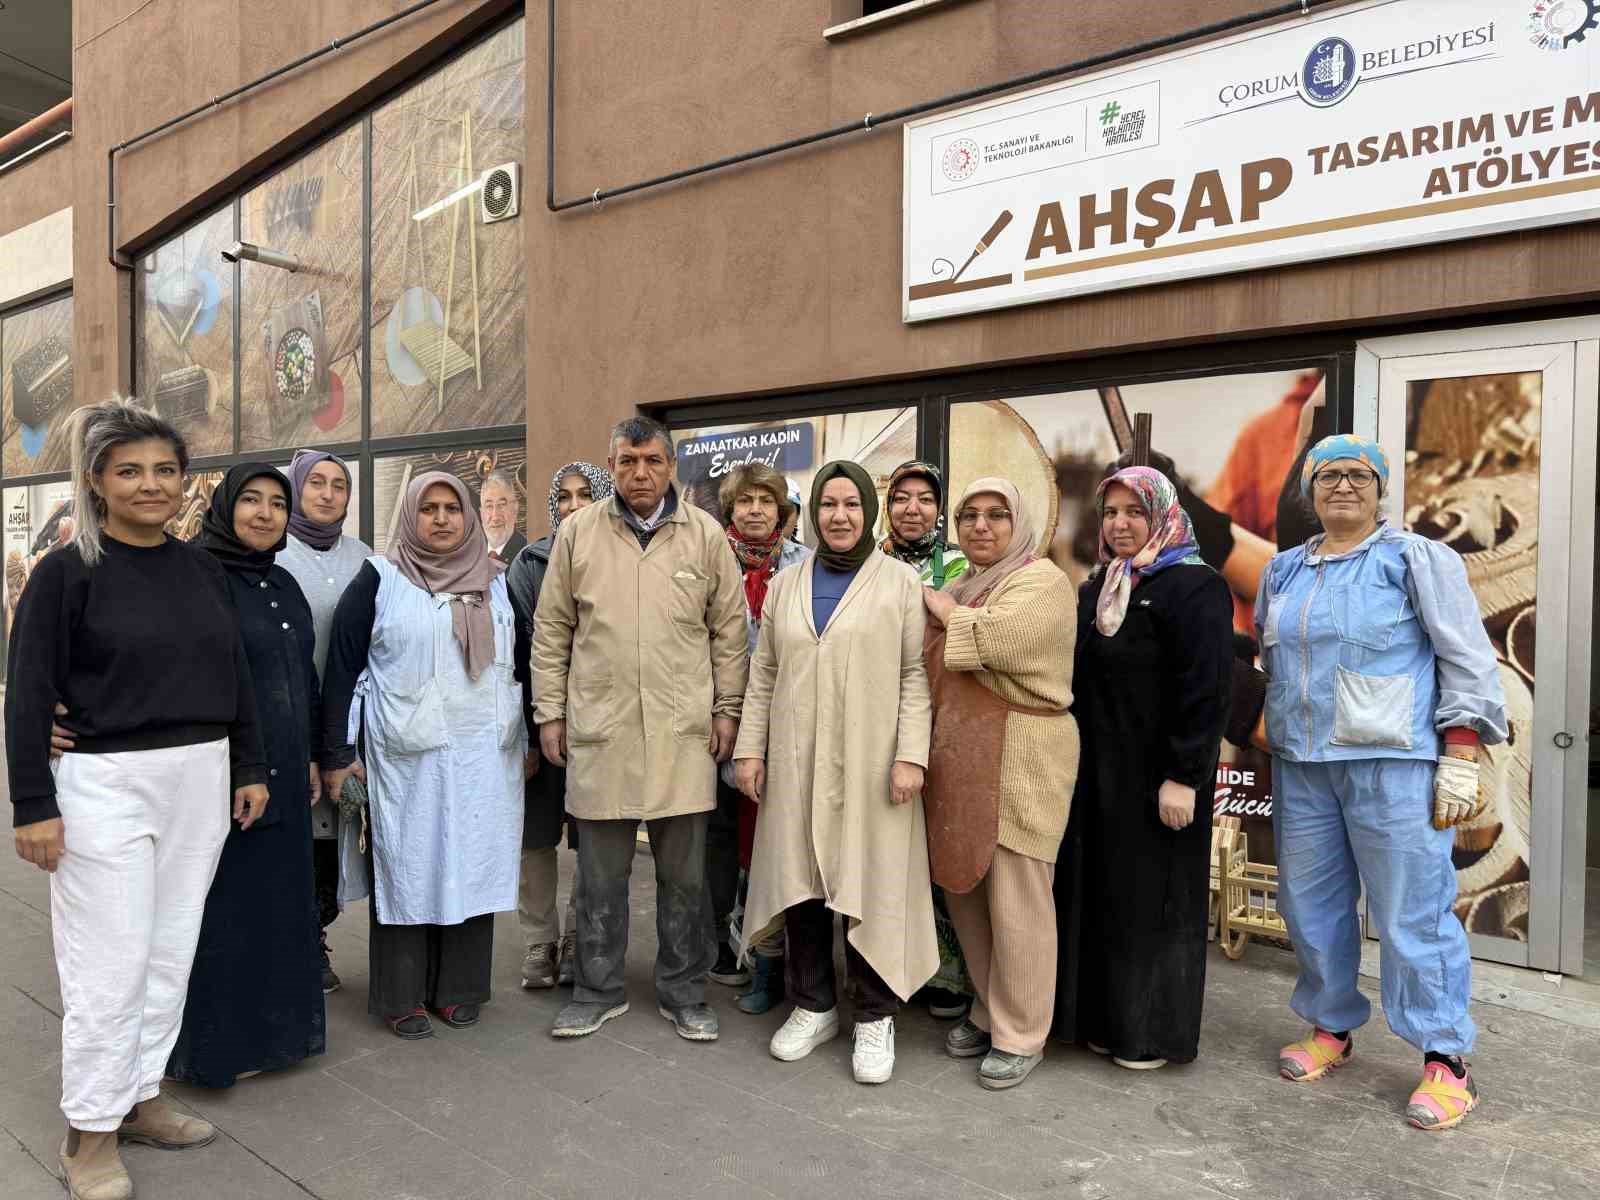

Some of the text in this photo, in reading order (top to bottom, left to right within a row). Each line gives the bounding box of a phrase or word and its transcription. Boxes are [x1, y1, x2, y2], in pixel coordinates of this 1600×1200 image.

[1218, 71, 1299, 107] ÇORUM
[1362, 21, 1495, 71] BELEDİYESİ
[984, 145, 1027, 163] TEKNOLOJİ
[1030, 134, 1041, 142] VE
[1307, 112, 1496, 176] TASARIM
[1504, 105, 1555, 138] VE
[1025, 157, 1293, 260] AHŞAP
[685, 429, 801, 456] ZANAATKAR KADIN
